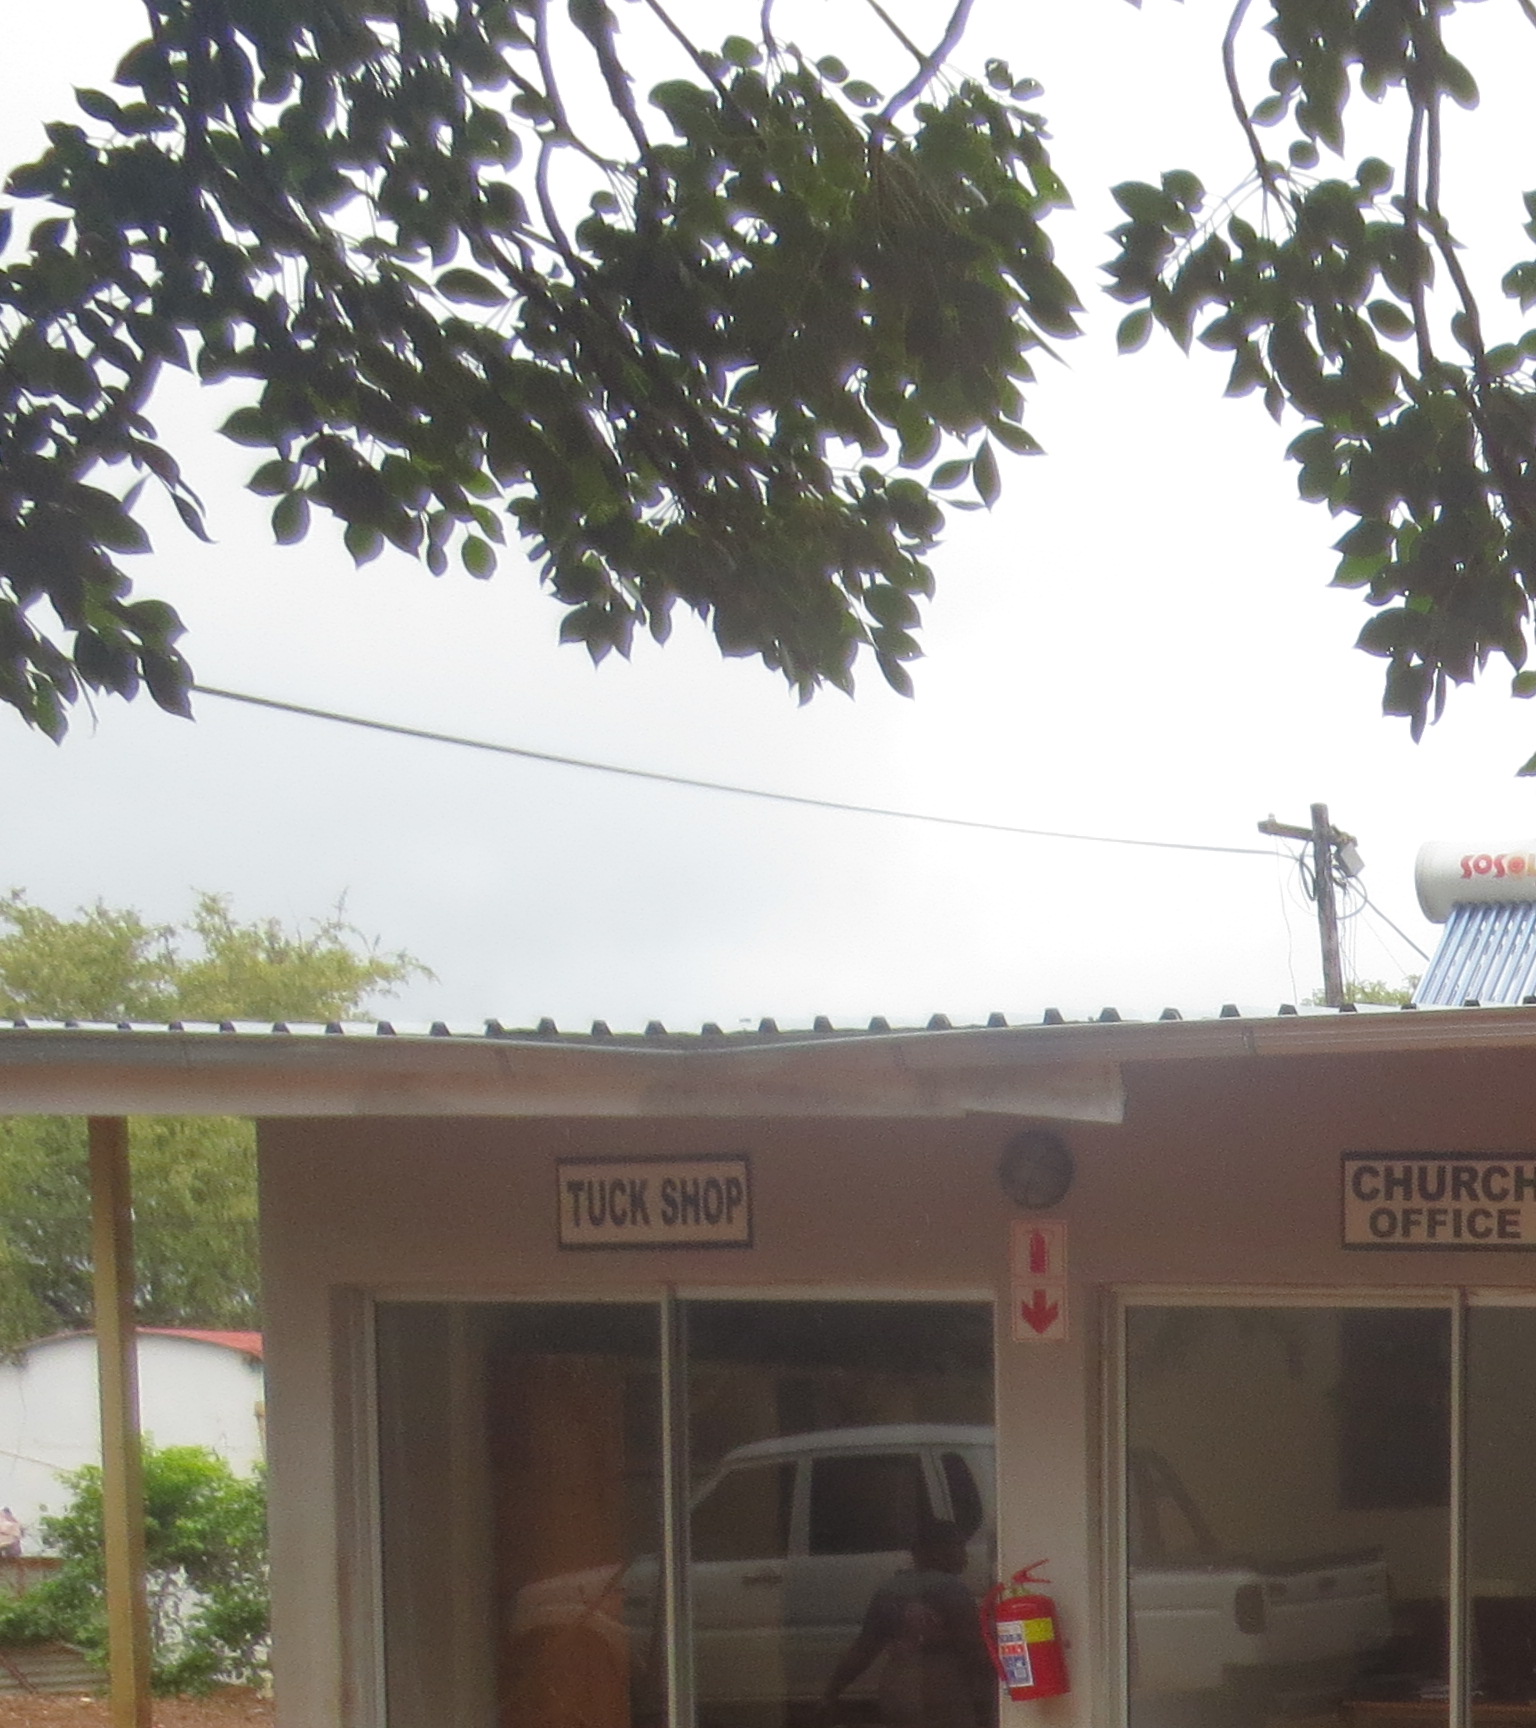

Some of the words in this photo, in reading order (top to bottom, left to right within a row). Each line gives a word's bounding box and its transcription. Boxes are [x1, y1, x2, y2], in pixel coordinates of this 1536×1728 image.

[567, 1178, 650, 1228] TUCK
[661, 1176, 744, 1226] SHOP
[1369, 1207, 1521, 1239] OFFICE
